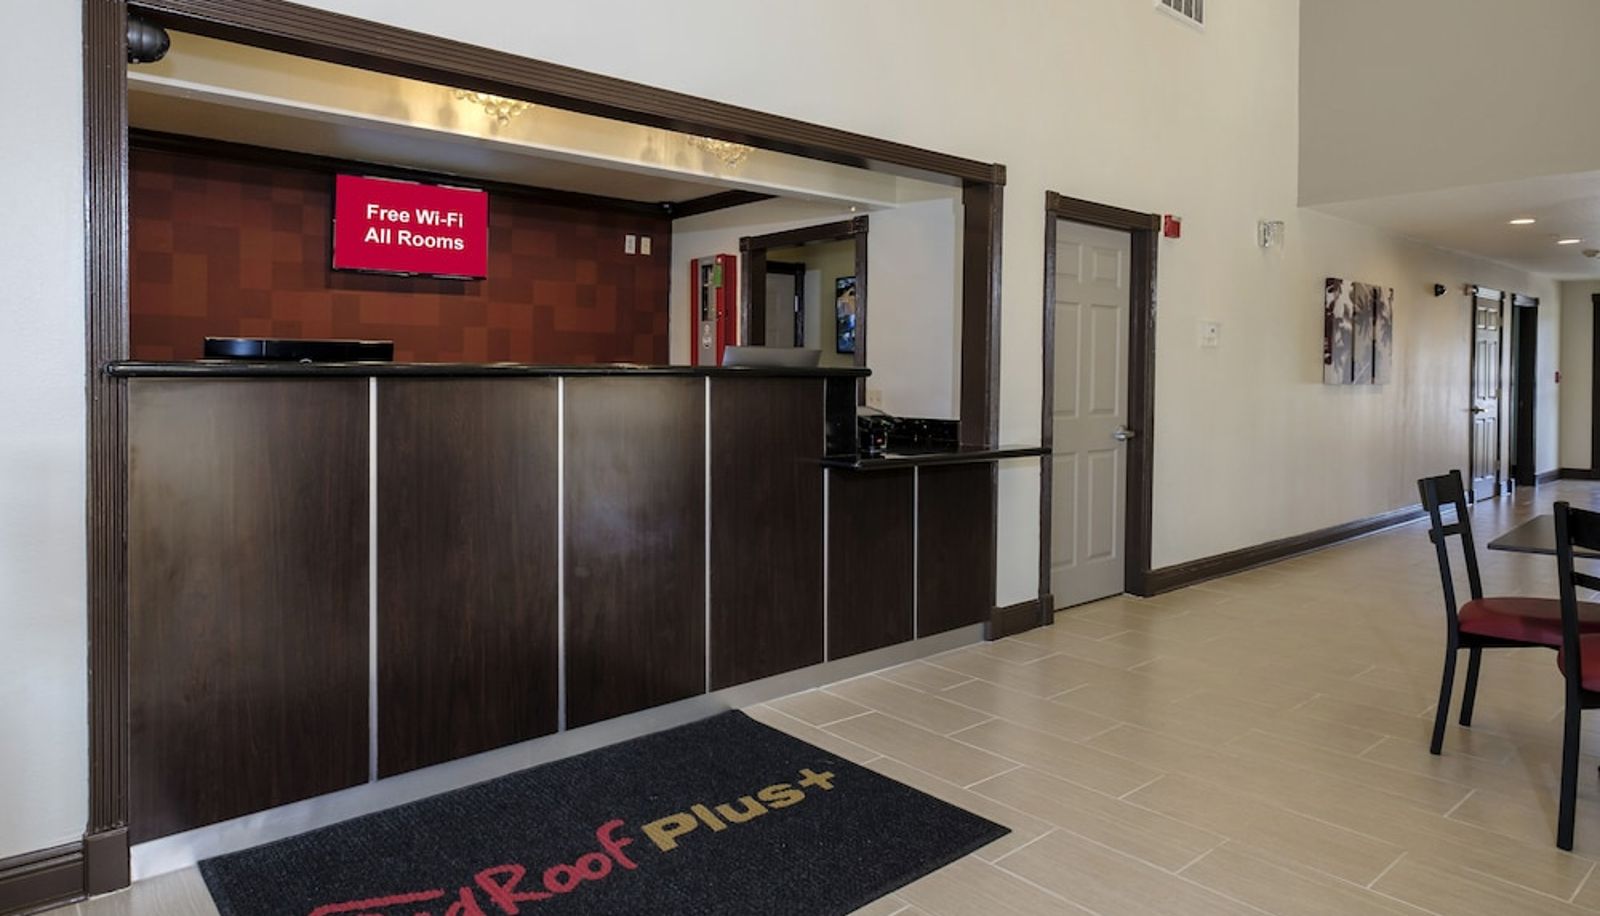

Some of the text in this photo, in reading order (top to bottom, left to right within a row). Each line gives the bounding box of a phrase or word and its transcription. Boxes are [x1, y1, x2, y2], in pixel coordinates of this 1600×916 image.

[366, 203, 464, 229] Free Wi-Fi
[364, 226, 465, 251] All Rooms
